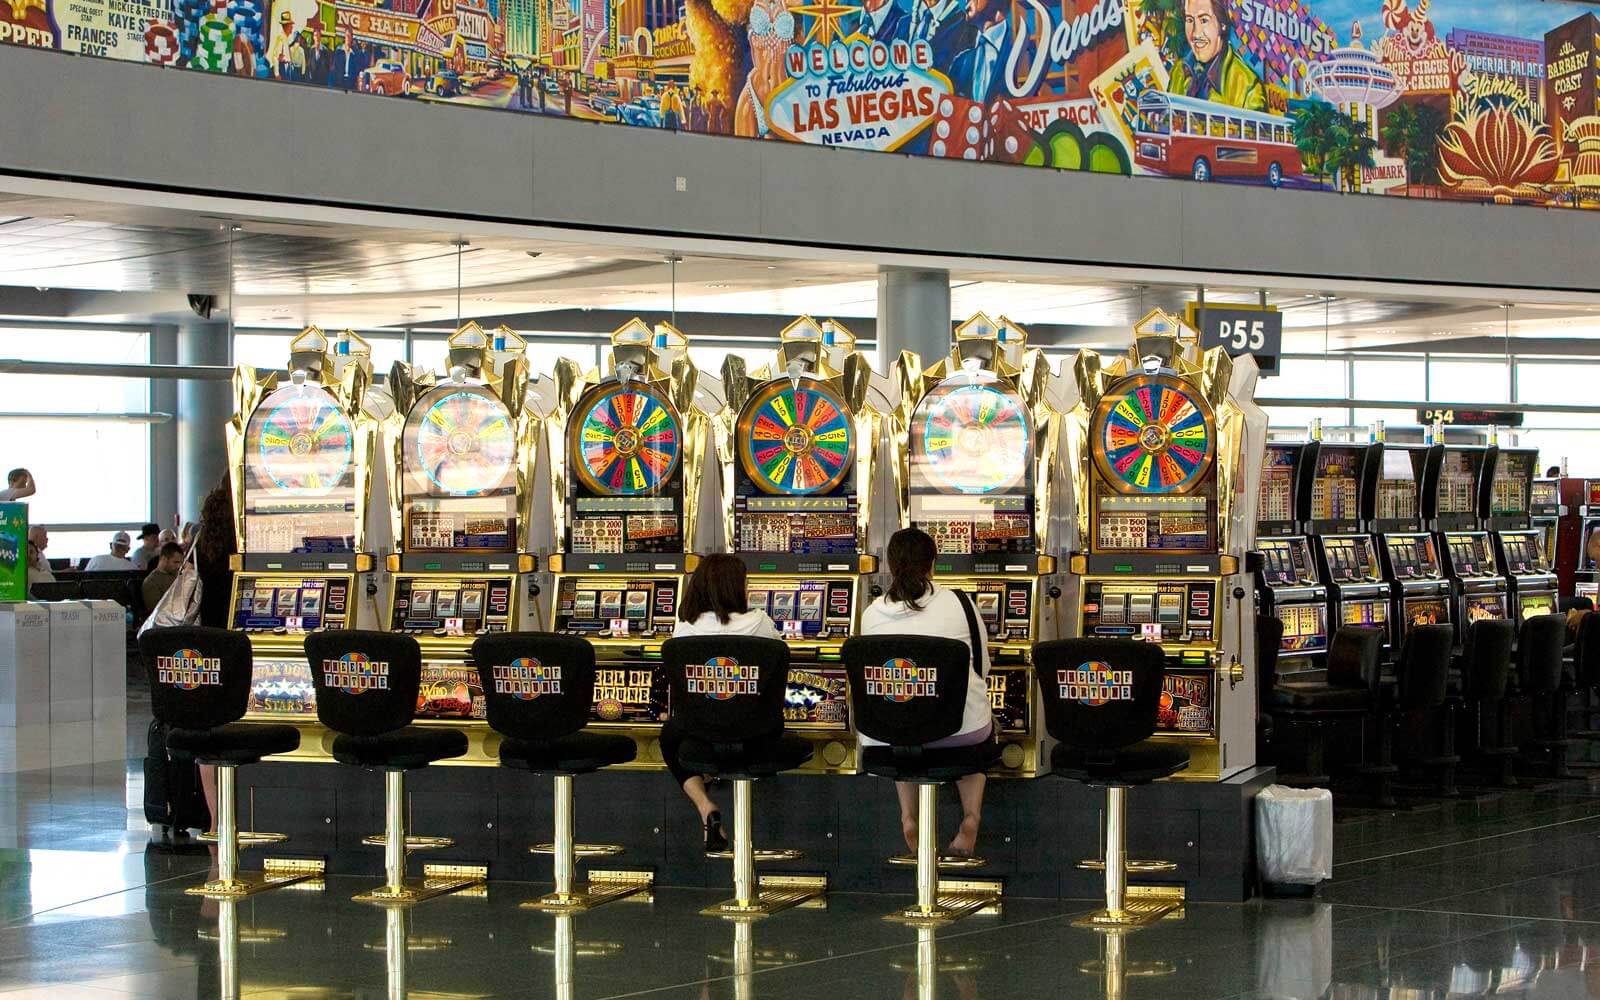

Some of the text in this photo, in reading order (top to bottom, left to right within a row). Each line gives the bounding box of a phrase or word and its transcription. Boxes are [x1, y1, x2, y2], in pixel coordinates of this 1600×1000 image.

[108, 0, 134, 14] MICKIE
[136, 6, 141, 15] &
[143, 7, 159, 18] FRED
[108, 12, 135, 30] KAYE
[369, 16, 410, 36] HALL
[1241, 0, 1332, 55] STARDUST
[68, 24, 118, 47] FRANCES
[80, 43, 107, 57] FAYE
[789, 44, 928, 73] WELCOME
[1465, 54, 1544, 77] IMPERIAL PALACE
[1548, 51, 1590, 79] BARBARY
[1412, 59, 1449, 75] CIRCUS
[806, 72, 909, 98] TO Fabulous
[1555, 73, 1583, 95] COAST
[793, 86, 935, 133] LAS VEGAS
[1058, 105, 1100, 125] PACK
[822, 126, 891, 145] NEVADA
[1362, 164, 1405, 184] LANDMARK
[607, 520, 621, 528] 2000
[157, 656, 221, 671] WHEEL OF
[323, 660, 365, 673] WHEEL
[371, 662, 389, 675] OF
[159, 671, 219, 684] FORTUNE
[493, 666, 561, 680] WHEEL OF
[629, 670, 652, 687] OF
[686, 665, 759, 680] WHEEL OF
[864, 666, 937, 681] WHEEL OF
[1057, 670, 1133, 685] WHEEL OF
[325, 674, 388, 689] FORTUNE
[496, 680, 561, 694] FORTUNE
[688, 679, 757, 694] FORTUNE
[788, 670, 840, 696] DOUBLE
[866, 681, 935, 696] FORTUNE
[1060, 684, 1131, 699] FORTUNE
[264, 698, 303, 711] STARS
